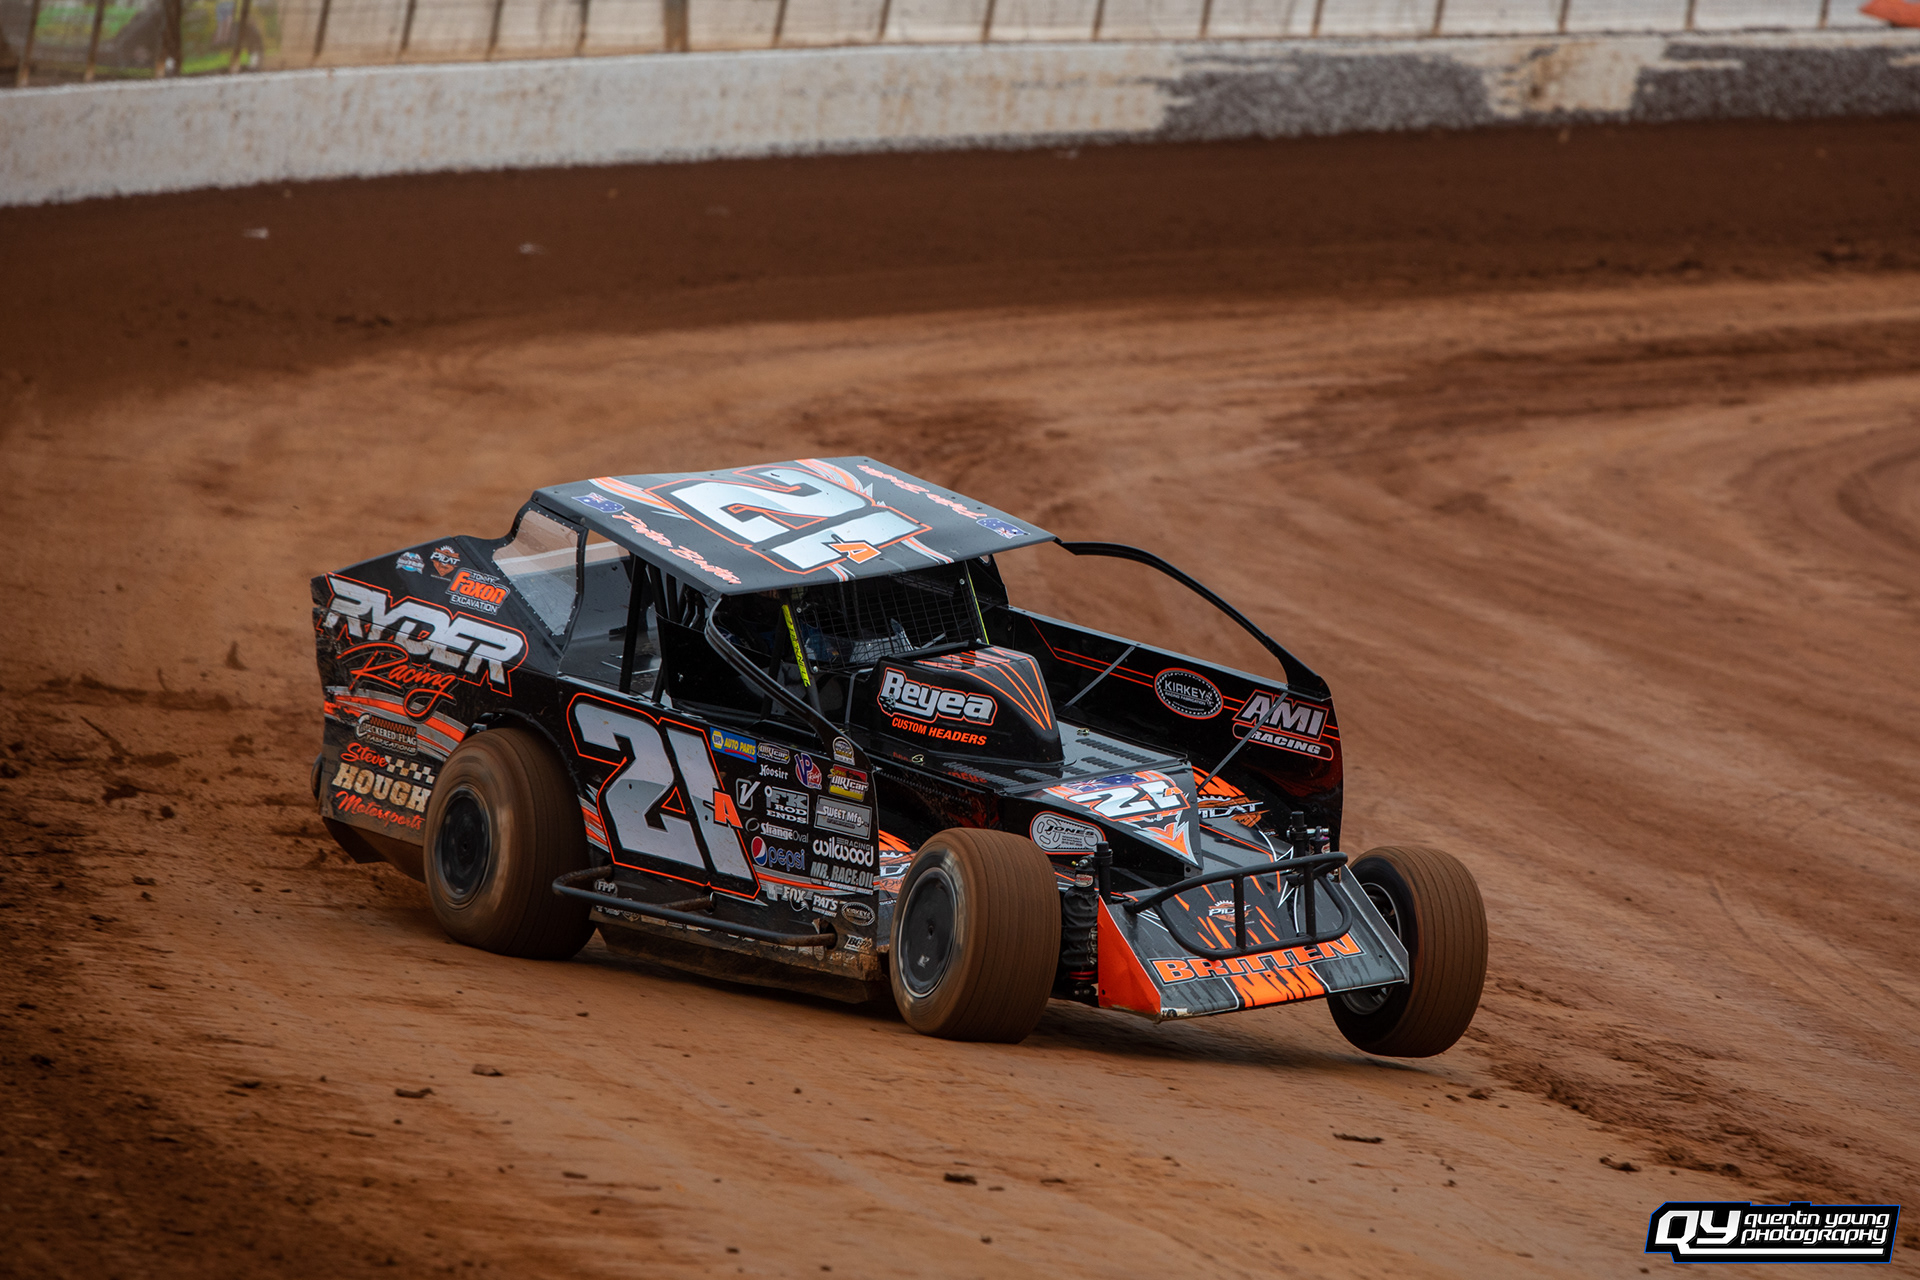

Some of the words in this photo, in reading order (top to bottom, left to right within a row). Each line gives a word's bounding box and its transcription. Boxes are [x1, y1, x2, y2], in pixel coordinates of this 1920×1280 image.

[450, 570, 507, 605] Faxon
[451, 595, 498, 614] EXCAVATION
[323, 577, 524, 685] RYDER
[336, 642, 458, 717] Racing
[1164, 680, 1206, 699] KIRKEY
[880, 670, 994, 720] Beyea
[1241, 695, 1323, 736] AMI
[398, 733, 417, 746] FLAG
[891, 717, 927, 736] CUSTOM
[928, 727, 988, 747] HEADERS
[1251, 731, 1321, 756] RACING
[340, 742, 388, 767] Steve
[724, 737, 739, 751] AUTO
[739, 741, 756, 756] PARTS
[794, 752, 813, 786] VP
[332, 762, 432, 813] HOUGH
[335, 791, 426, 830] Motorsports
[766, 809, 807, 824] ENDS
[774, 804, 807, 816] ROD
[816, 805, 847, 820] SWEET
[760, 822, 793, 840] Strange
[792, 830, 809, 843] Oval
[1044, 825, 1095, 837] JONES
[812, 836, 874, 867] wilwood
[845, 839, 871, 851] RACING
[768, 846, 806, 872] pepsi
[810, 861, 829, 880] MR.
[858, 870, 874, 889] OIL
[1152, 932, 1362, 983] BRITTEN
